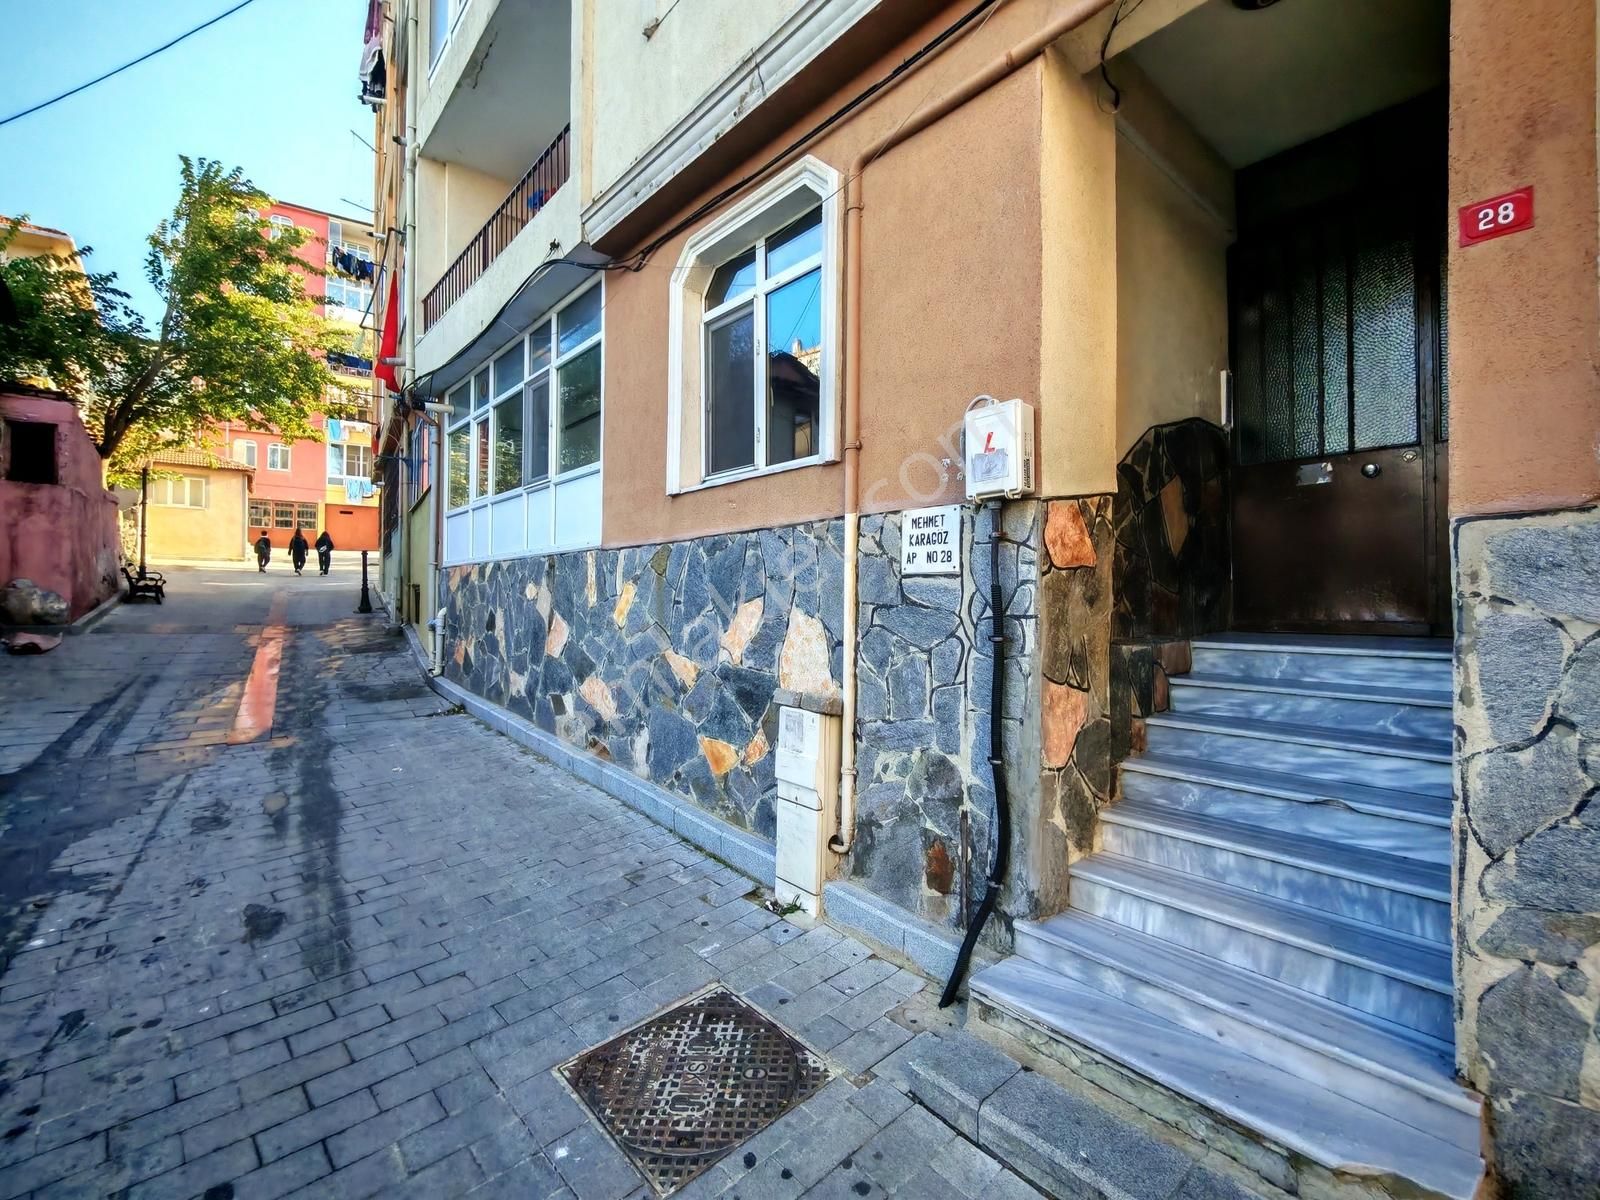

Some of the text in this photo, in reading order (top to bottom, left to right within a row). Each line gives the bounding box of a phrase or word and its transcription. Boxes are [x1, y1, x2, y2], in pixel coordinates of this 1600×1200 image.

[1478, 202, 1515, 231] 28
[911, 514, 946, 529] MEHMET
[909, 529, 949, 547] KARAGÖZ
[906, 550, 952, 565] AP NO 28
